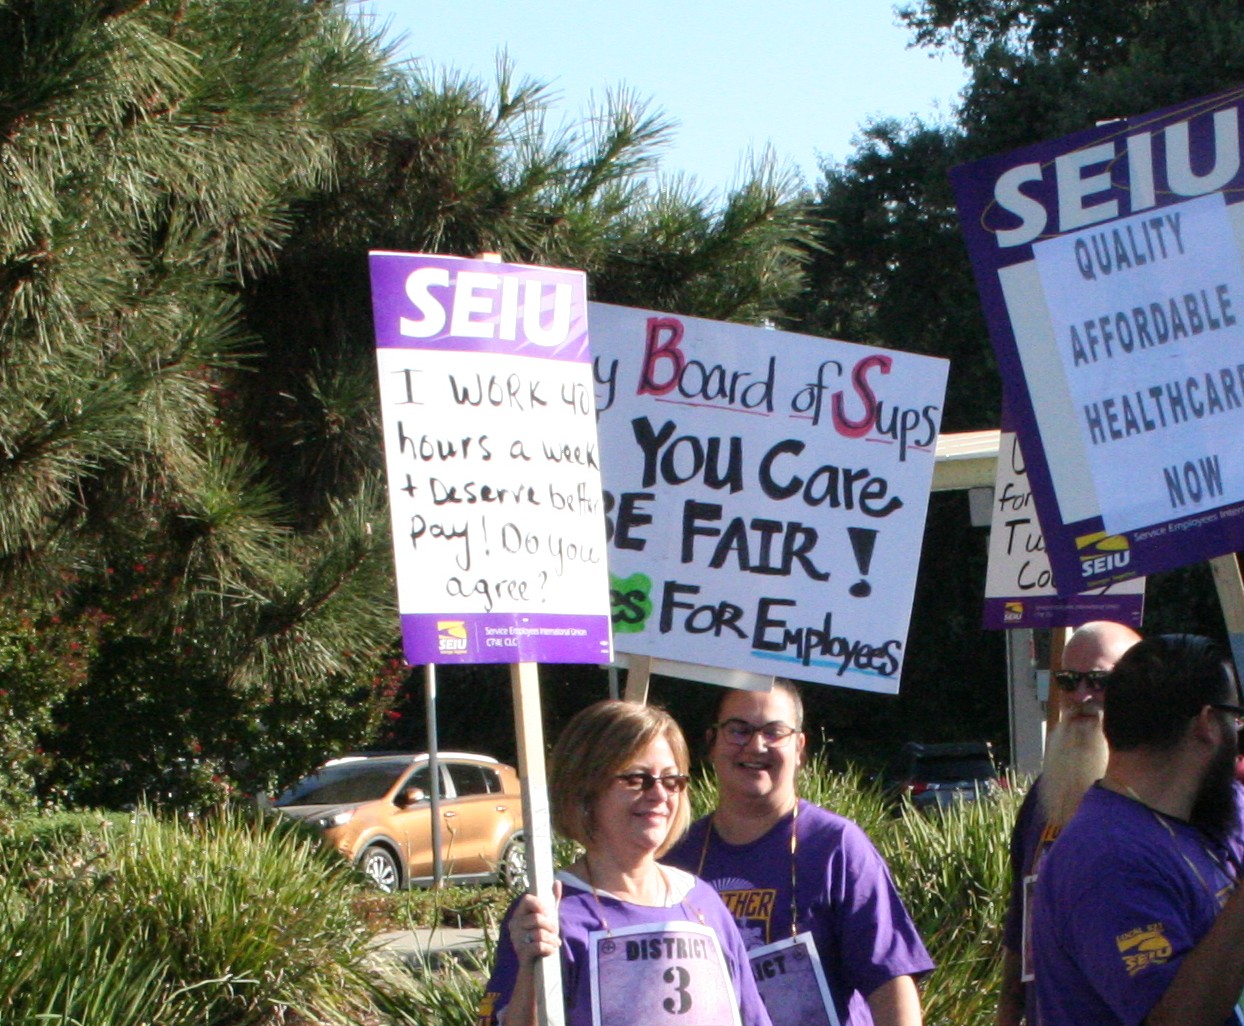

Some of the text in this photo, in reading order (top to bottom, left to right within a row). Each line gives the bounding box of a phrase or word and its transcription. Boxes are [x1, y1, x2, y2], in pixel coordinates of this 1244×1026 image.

[994, 106, 1240, 249] SEIU
[1073, 212, 1187, 281] QUALITY
[400, 267, 573, 347] SEIU
[1068, 283, 1237, 368] AFFORDABLE
[391, 368, 591, 415] I WORK 40
[636, 316, 776, 414] Board
[791, 360, 843, 426] of
[831, 354, 940, 462] Sups
[397, 420, 600, 471] hours a week
[429, 476, 541, 506] Deserve
[758, 439, 903, 518] Care
[1162, 454, 1225, 509] NOW
[501, 522, 539, 555] Do
[548, 533, 600, 576] you
[1134, 527, 1167, 542] Service
[1081, 550, 1131, 577] SEIU
[446, 570, 548, 613] agree?
[659, 580, 749, 639] FOR
[438, 638, 467, 650] SEIU
[625, 937, 709, 962] DISTRICT
[1122, 947, 1172, 972] SEIU
[662, 966, 693, 1015] 3
